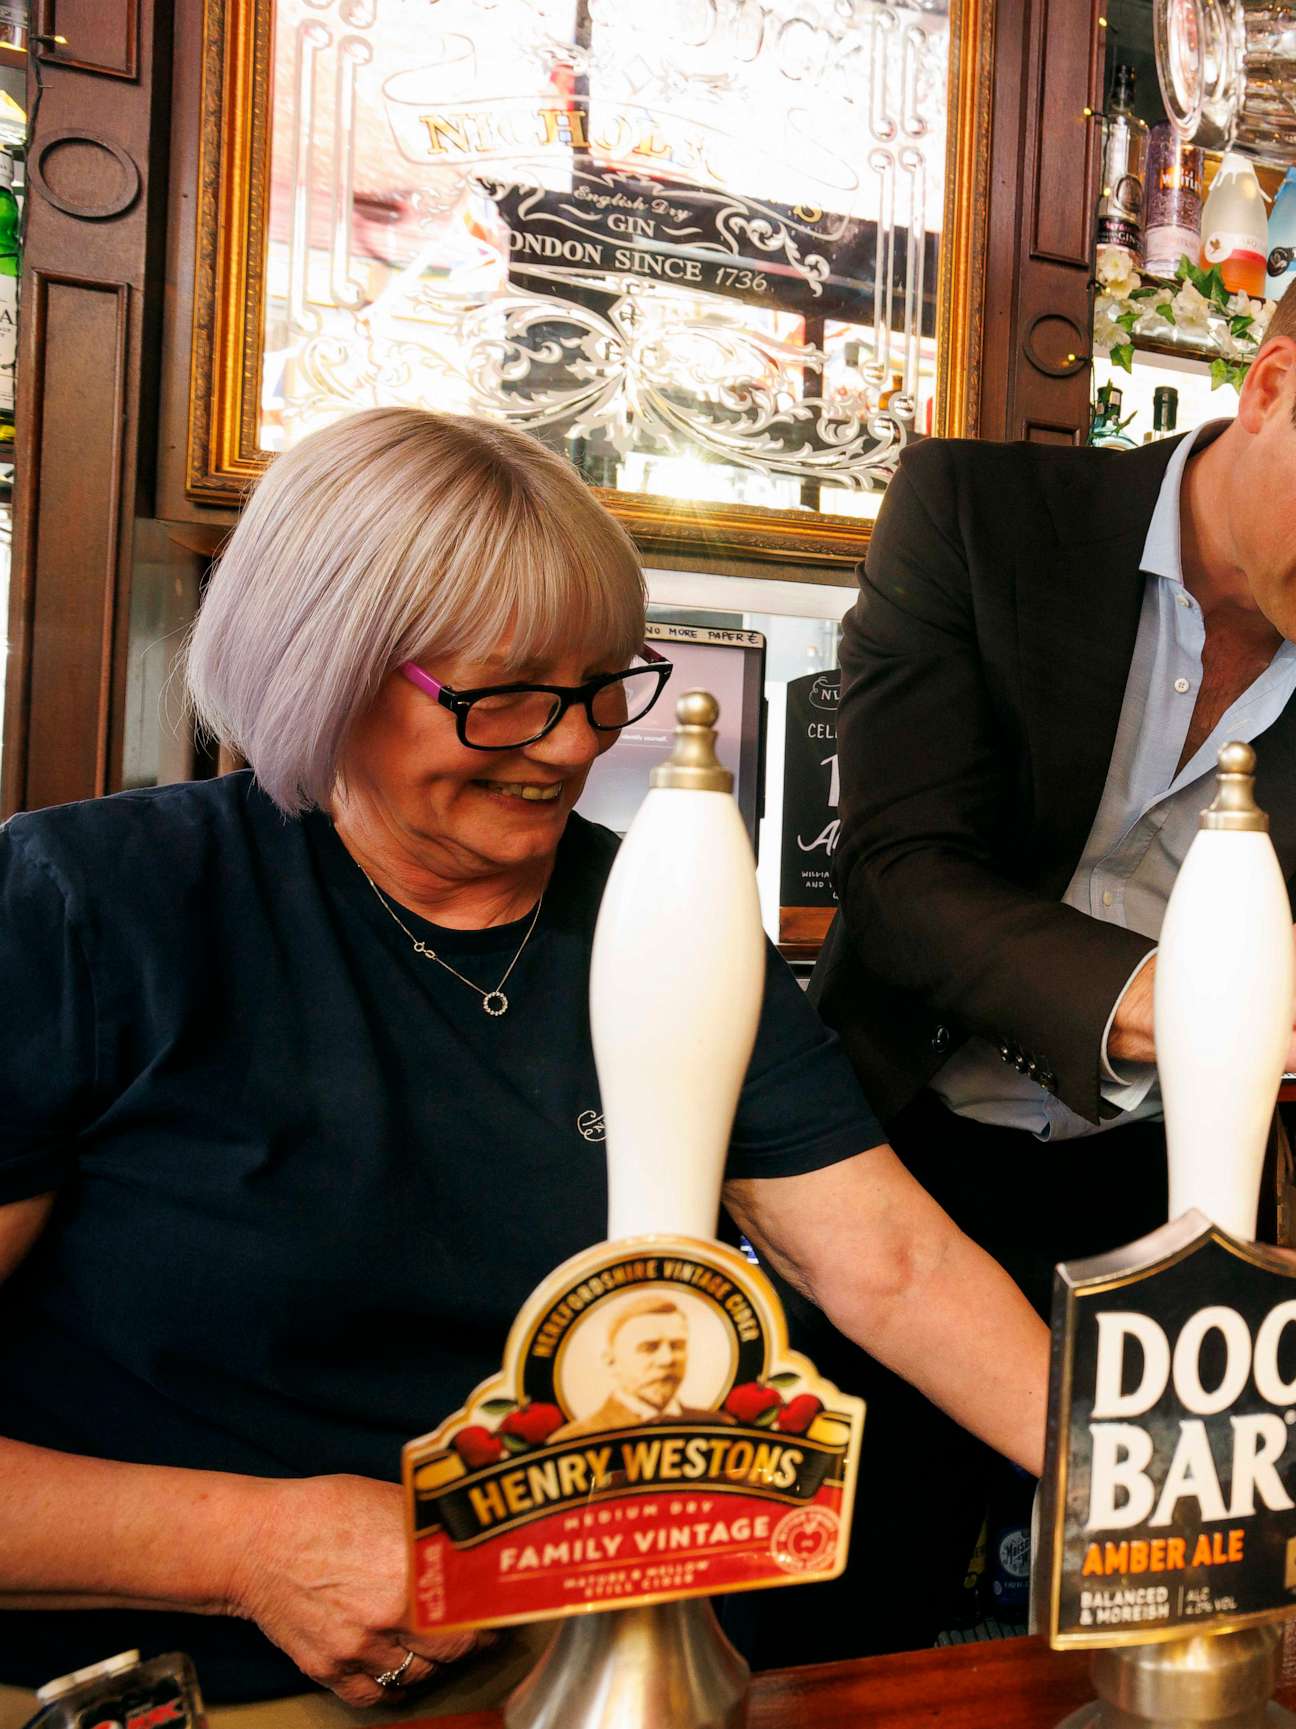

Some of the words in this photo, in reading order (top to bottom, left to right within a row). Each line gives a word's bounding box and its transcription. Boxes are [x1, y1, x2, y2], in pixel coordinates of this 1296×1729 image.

[573, 184, 648, 210] English
[651, 199, 693, 222] Dry
[607, 213, 656, 236] GIN
[508, 231, 604, 265] ONDON
[614, 250, 703, 282] SINCE
[714, 266, 768, 292] 1736
[668, 627, 698, 639] MORE
[708, 631, 744, 642] PAPER
[468, 1442, 614, 1527] HENRY
[621, 1438, 804, 1489] WESTONS
[563, 1504, 659, 1531] MEDIUM
[669, 1500, 714, 1516] DRY
[500, 1533, 624, 1573] FAMILY
[632, 1515, 771, 1554] VINTAGE
[1082, 1536, 1186, 1577] AMBER
[1191, 1528, 1246, 1567] ALE
[1079, 1585, 1169, 1610] BALANCED
[1095, 1601, 1170, 1625] MOREISH
